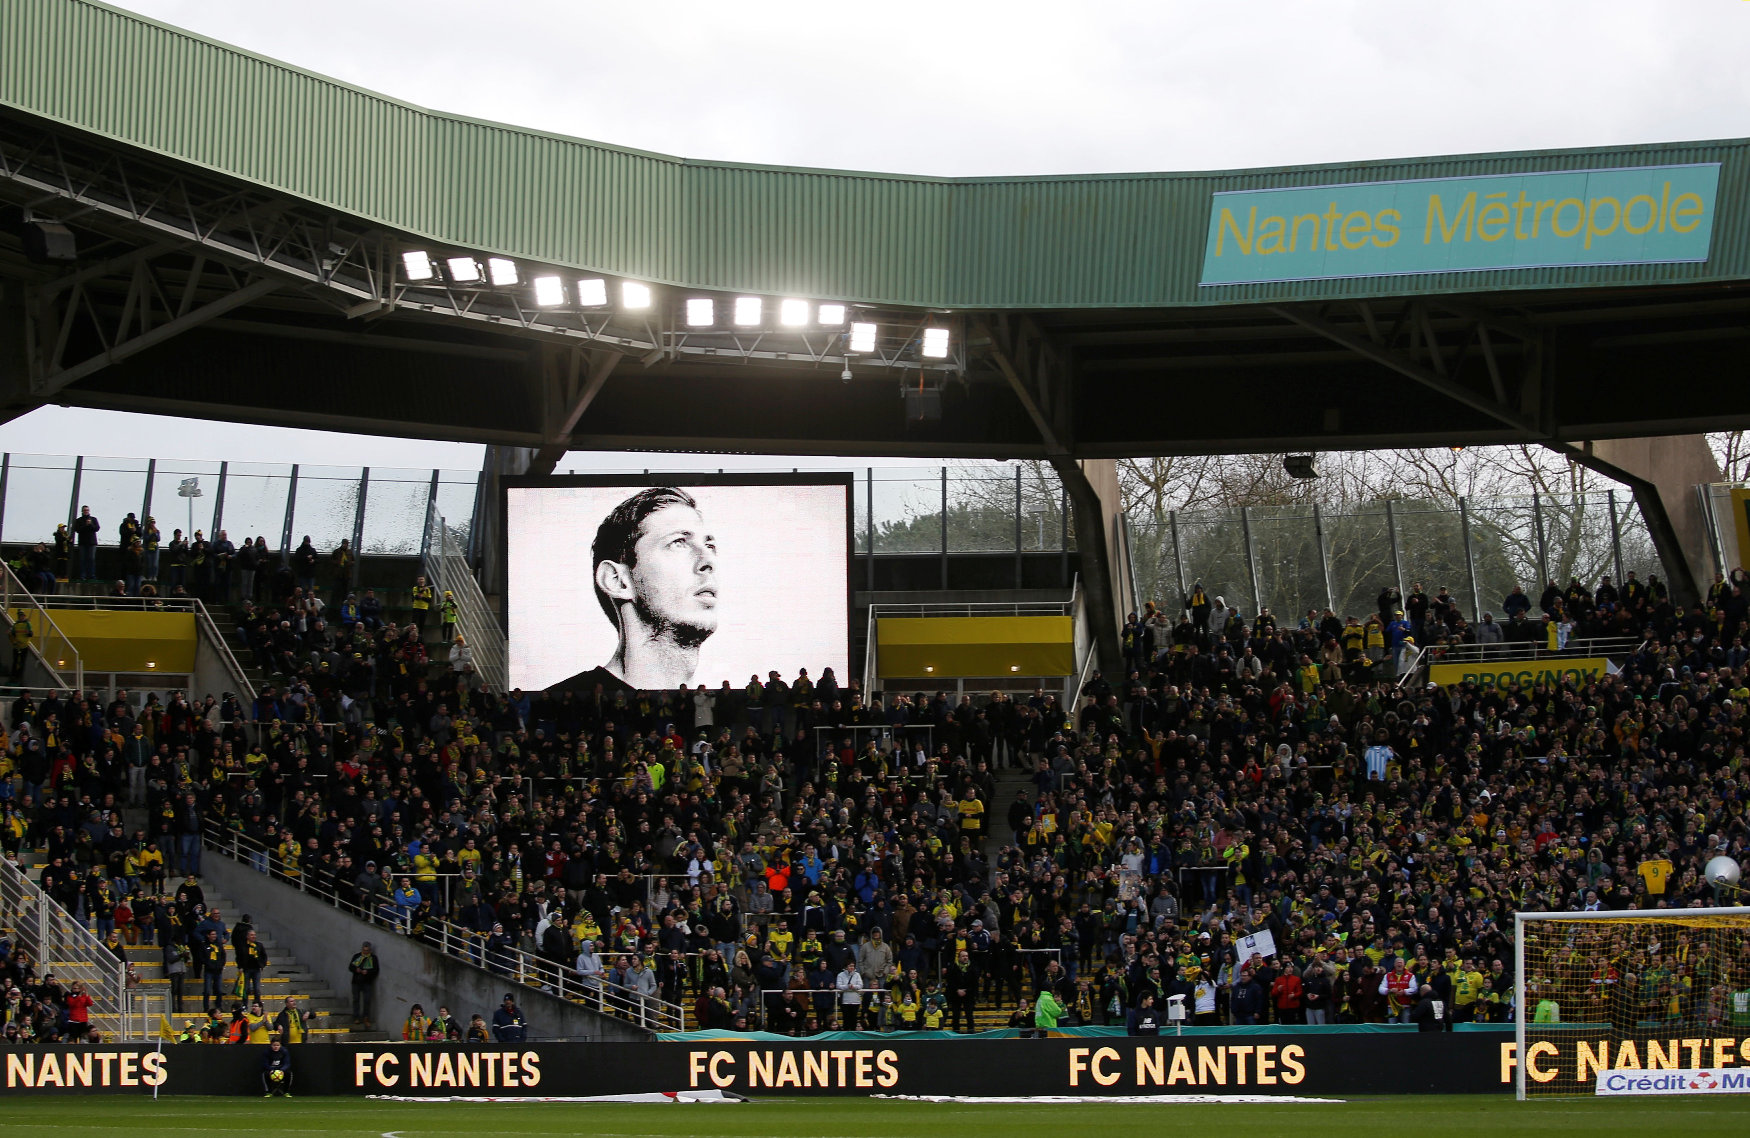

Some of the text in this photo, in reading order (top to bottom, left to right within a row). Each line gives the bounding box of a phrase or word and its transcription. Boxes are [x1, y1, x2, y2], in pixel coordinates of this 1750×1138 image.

[1214, 181, 1704, 258] Nantes Métropole
[1651, 867, 1659, 878] 9
[6, 1052, 168, 1088] NANTES
[355, 1051, 541, 1087] FC NANTES
[689, 1049, 899, 1088] FC NANTES
[1069, 1044, 1306, 1086] FC NANTES
[1606, 1074, 1686, 1091] Crédit
